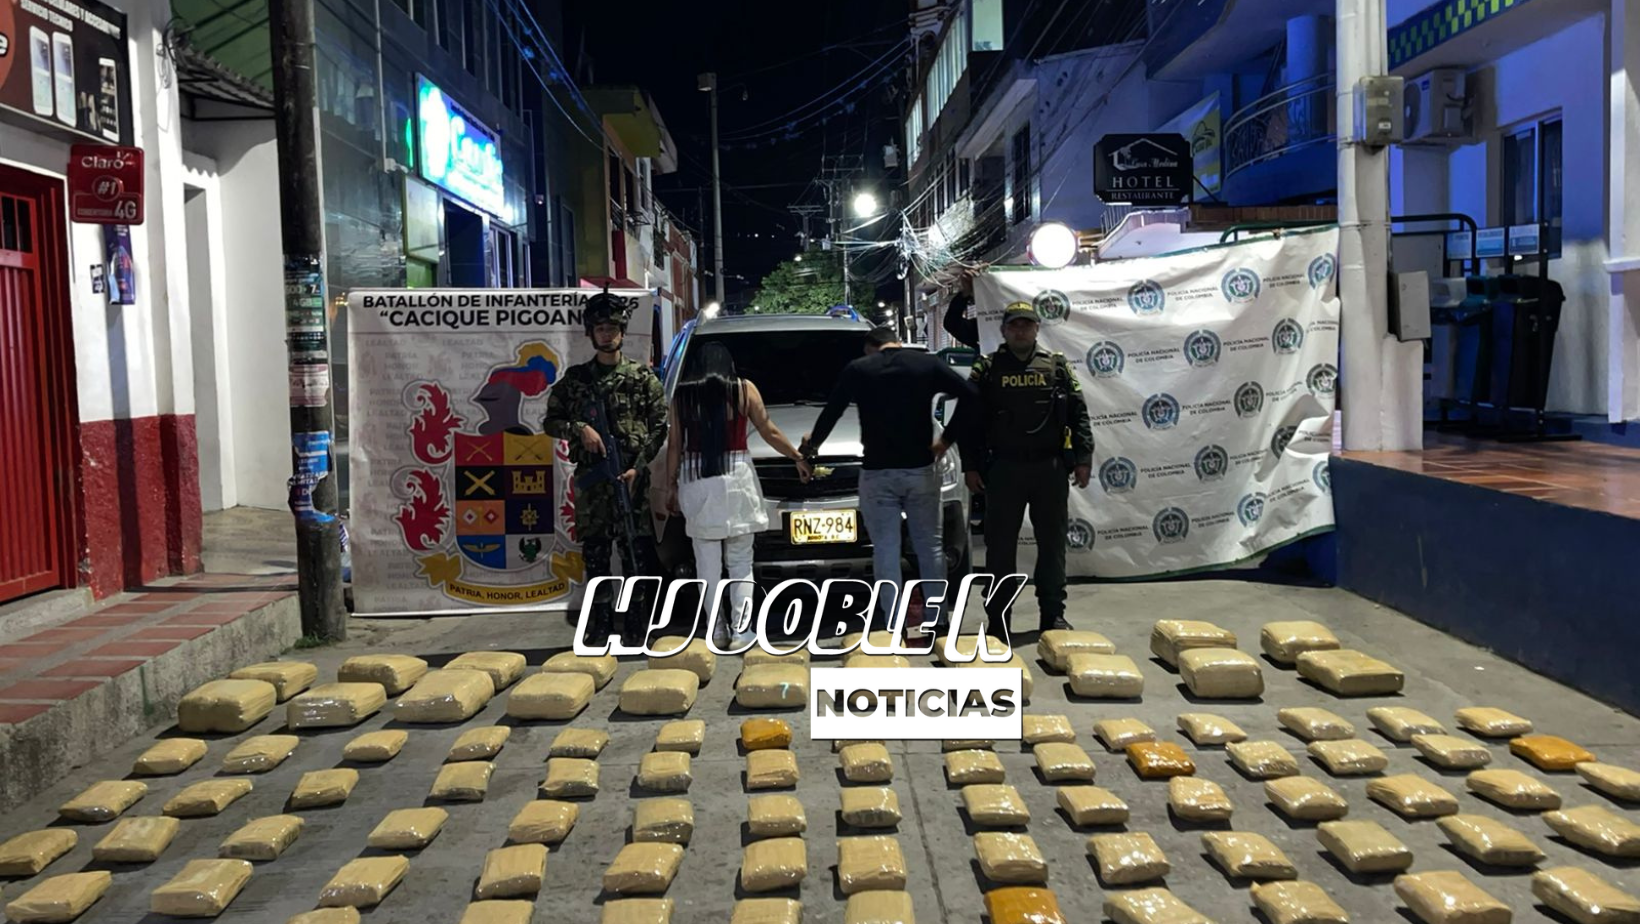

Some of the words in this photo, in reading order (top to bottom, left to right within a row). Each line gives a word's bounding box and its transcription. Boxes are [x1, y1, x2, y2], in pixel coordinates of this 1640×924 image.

[81, 155, 125, 169] Claro
[97, 181, 116, 195] #1
[1112, 176, 1174, 188] HOTEL
[1111, 192, 1174, 200] RESTAURANTE
[114, 200, 137, 219] 4G
[363, 292, 455, 309] BATALLÓN
[457, 294, 481, 308] DE
[485, 291, 588, 307] INFANTERÍA
[793, 516, 853, 536] RNZ-984
[525, 582, 566, 599] LEALTAD
